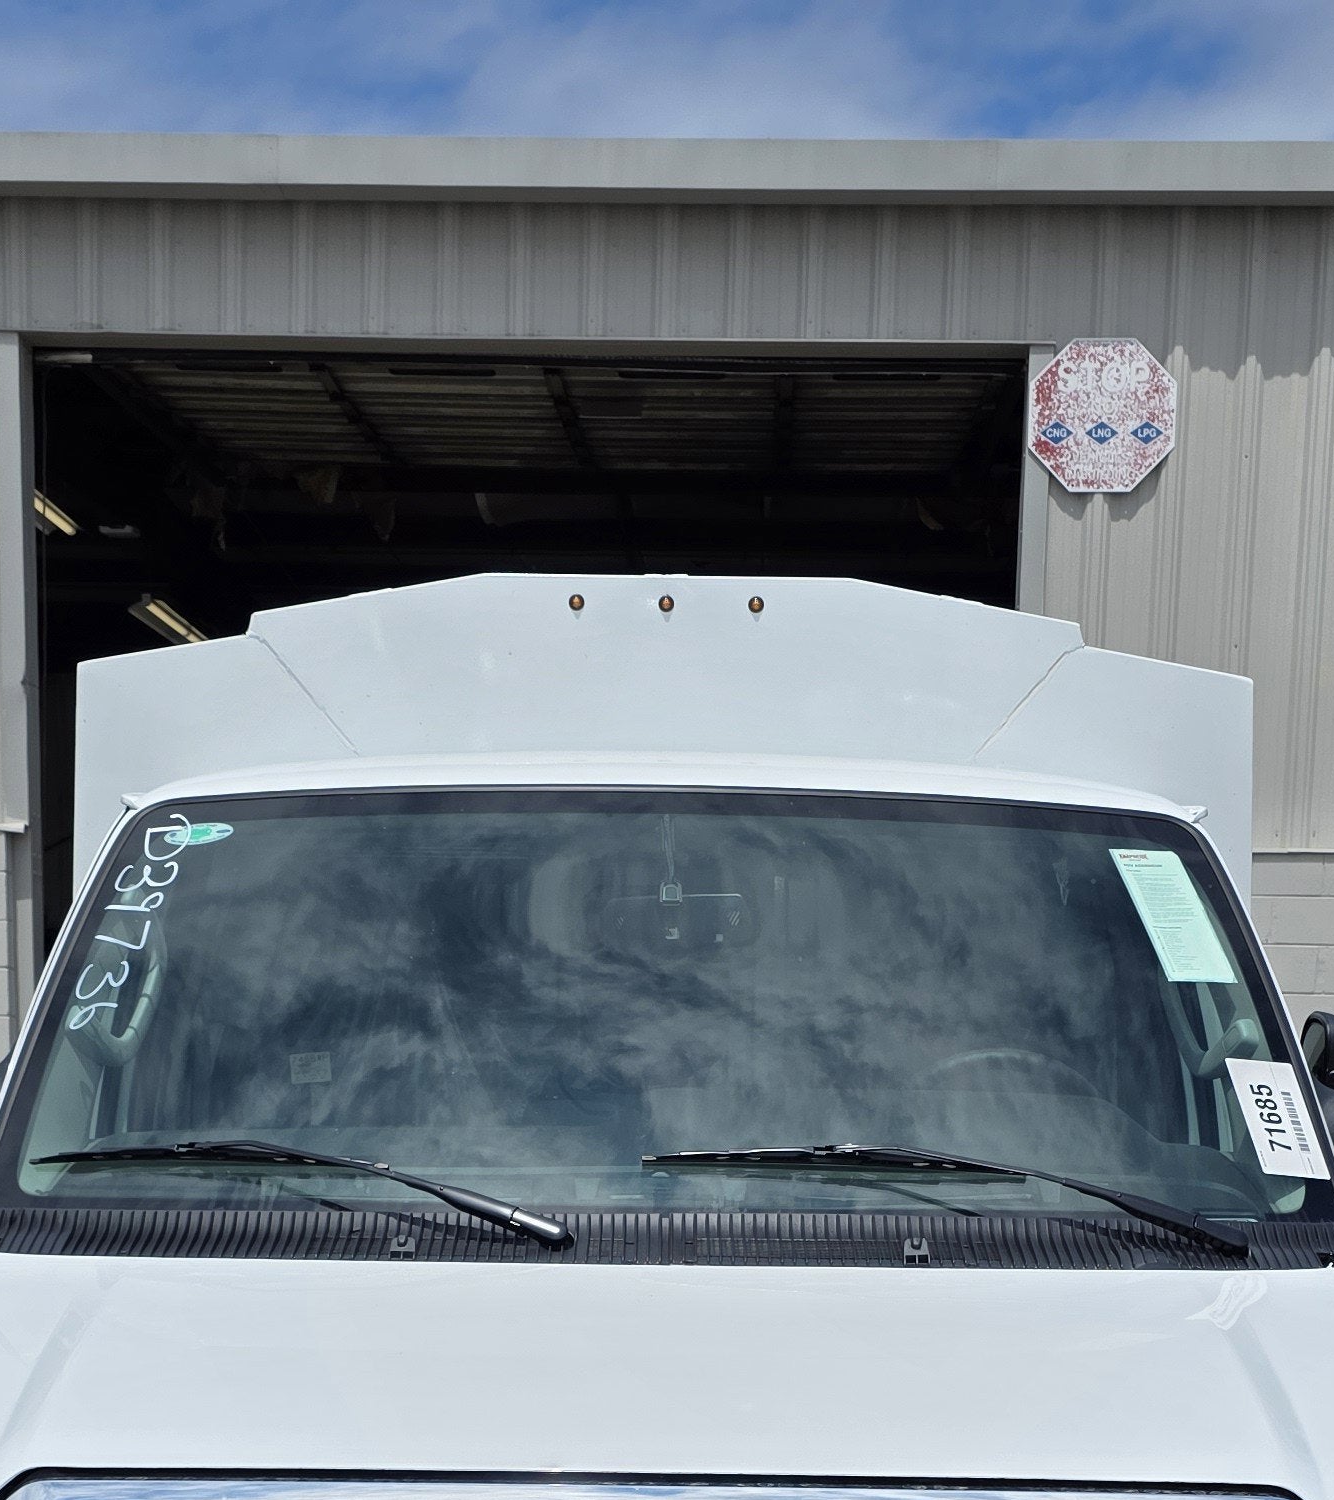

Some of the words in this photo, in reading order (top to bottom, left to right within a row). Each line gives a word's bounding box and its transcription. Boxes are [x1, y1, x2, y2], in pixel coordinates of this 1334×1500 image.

[1057, 358, 1151, 393] STOP
[1045, 428, 1068, 438] CNG
[1091, 428, 1112, 438] LNG
[1137, 428, 1157, 438] LPG
[68, 813, 192, 1030] D39736
[1248, 1083, 1293, 1152] 71685
